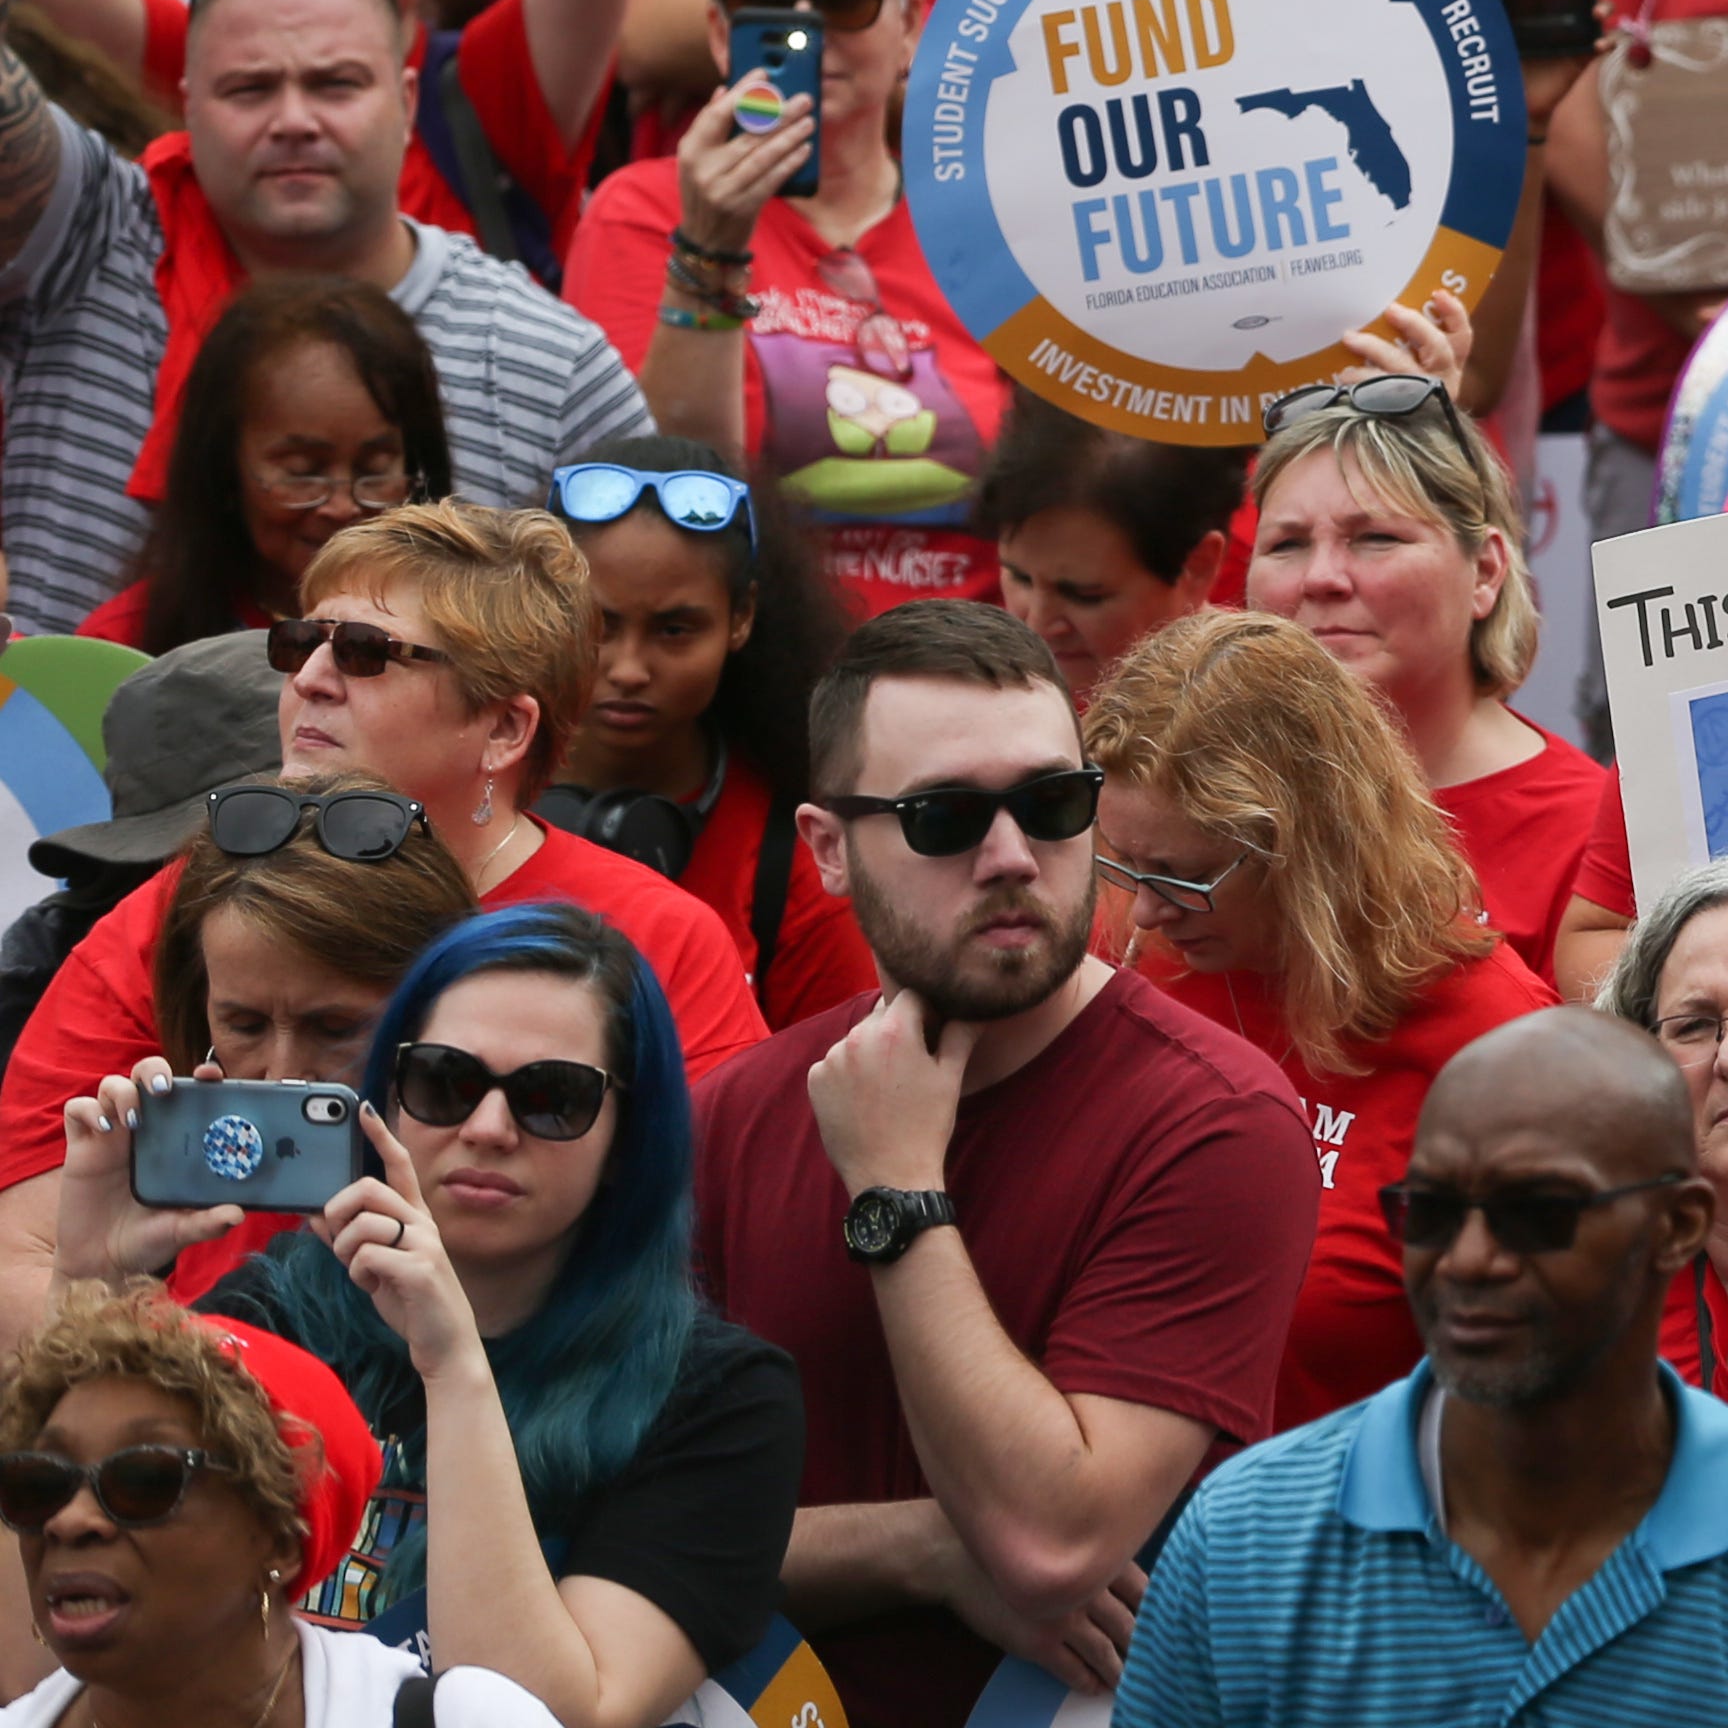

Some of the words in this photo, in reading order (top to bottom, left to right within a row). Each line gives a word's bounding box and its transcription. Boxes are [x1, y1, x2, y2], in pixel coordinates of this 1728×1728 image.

[932, 40, 979, 182] STUDENT
[1056, 85, 1211, 190] OUR
[1071, 155, 1352, 284] FUTURE
[1085, 281, 1134, 311] FLORIDA
[1135, 275, 1201, 305] EDUCATION
[1200, 264, 1277, 295] ASSOCIATION
[1026, 336, 1213, 426] INVESTMENT
[1218, 397, 1252, 425] IN
